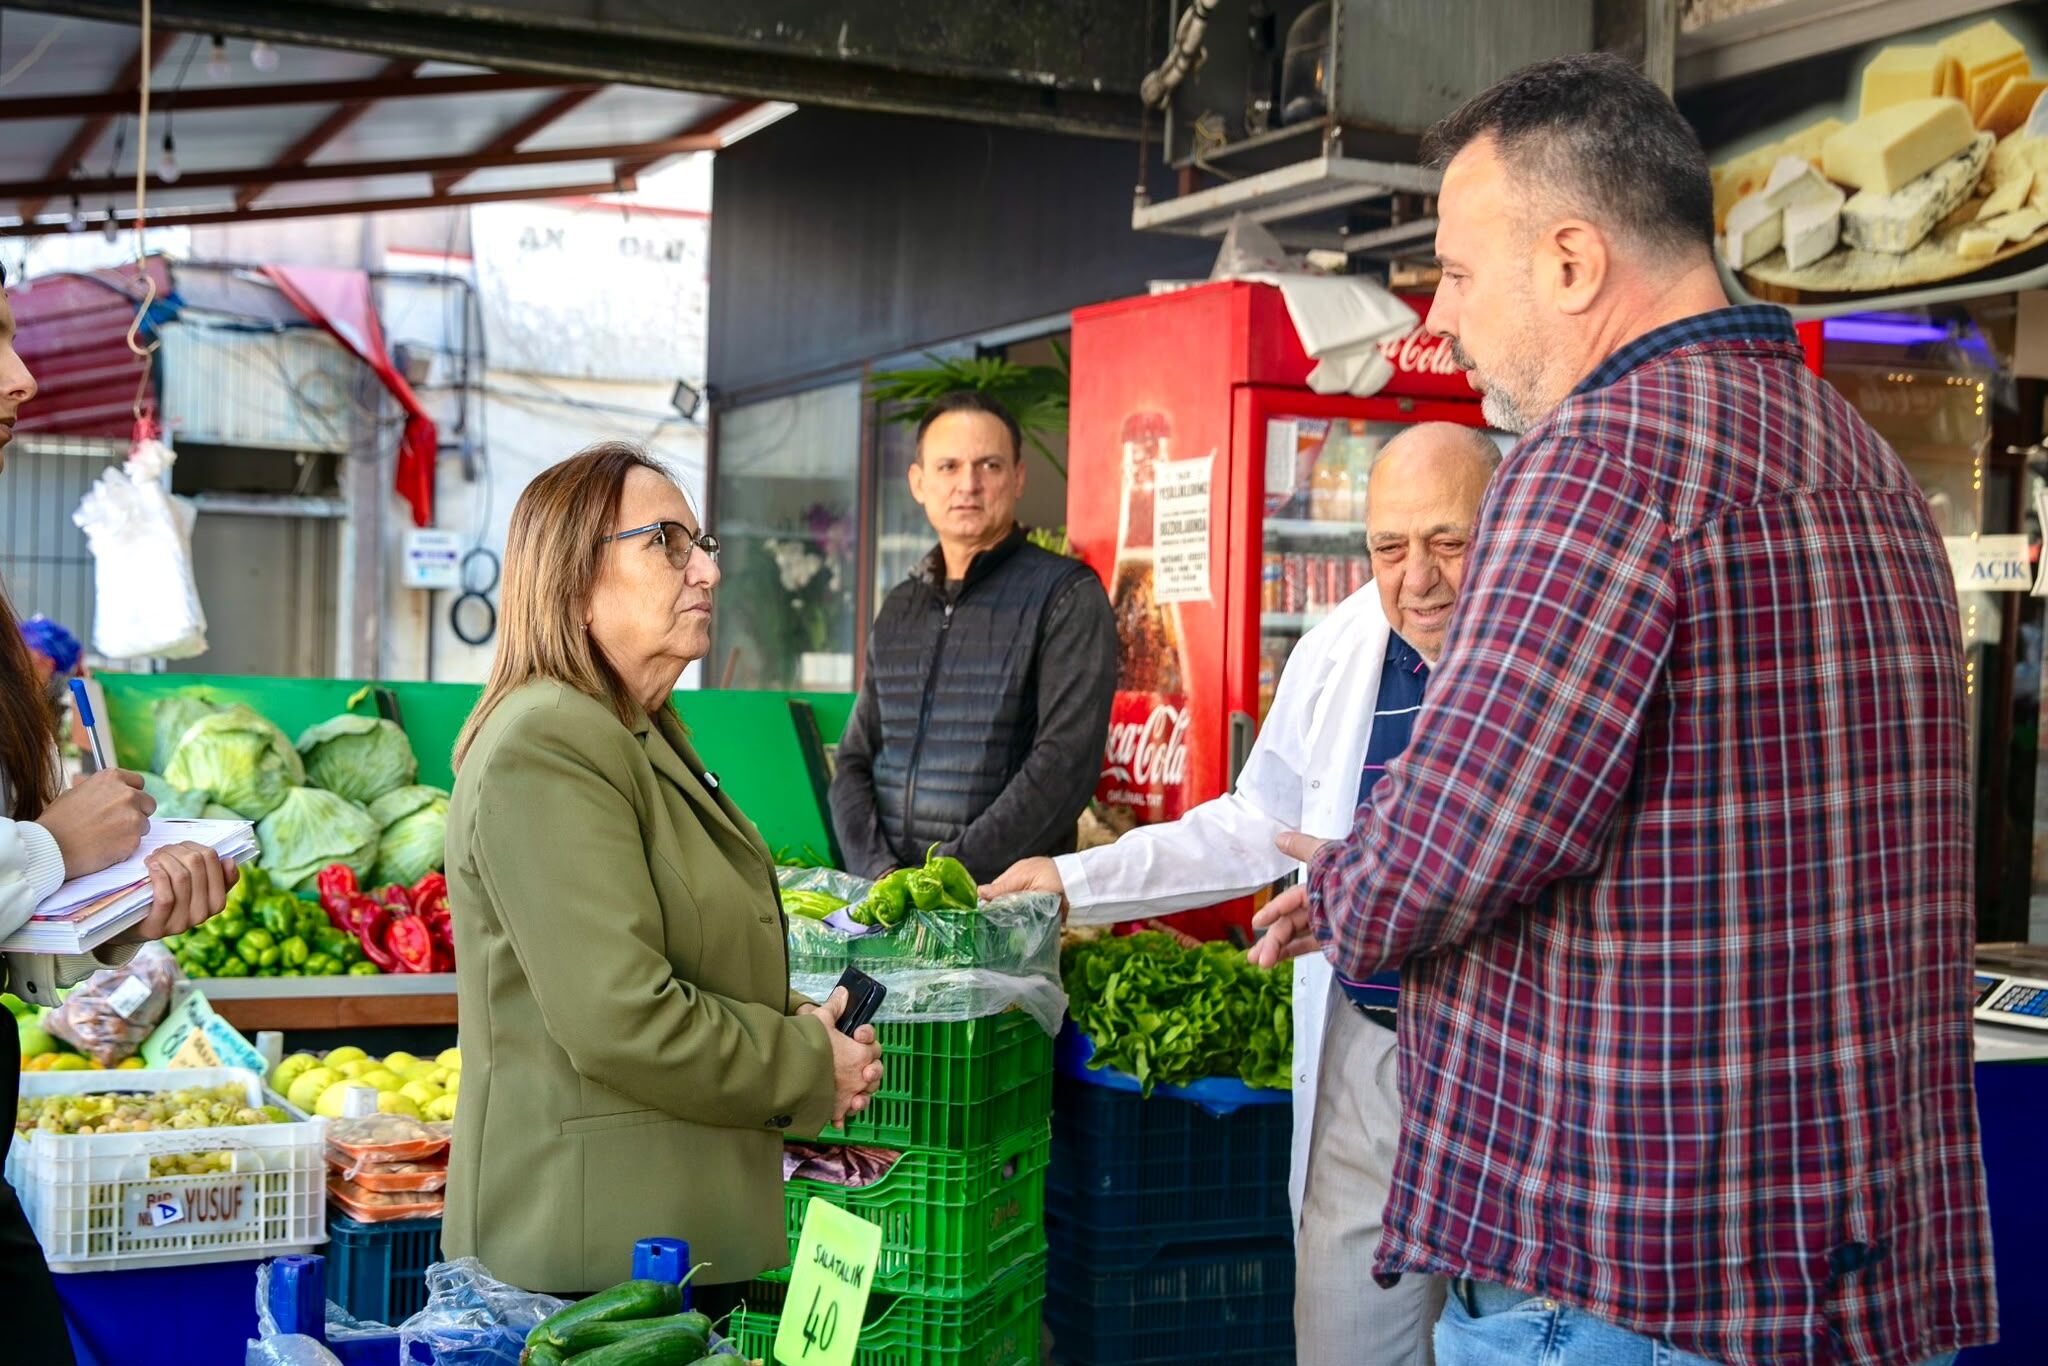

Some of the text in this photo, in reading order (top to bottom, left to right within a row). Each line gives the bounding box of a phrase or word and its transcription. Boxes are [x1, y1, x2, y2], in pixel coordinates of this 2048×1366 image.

[1971, 560, 2026, 583] AÇIK
[185, 1184, 243, 1223] YUSUF
[813, 1244, 865, 1289] SALATALIK
[803, 1285, 838, 1358] 40
